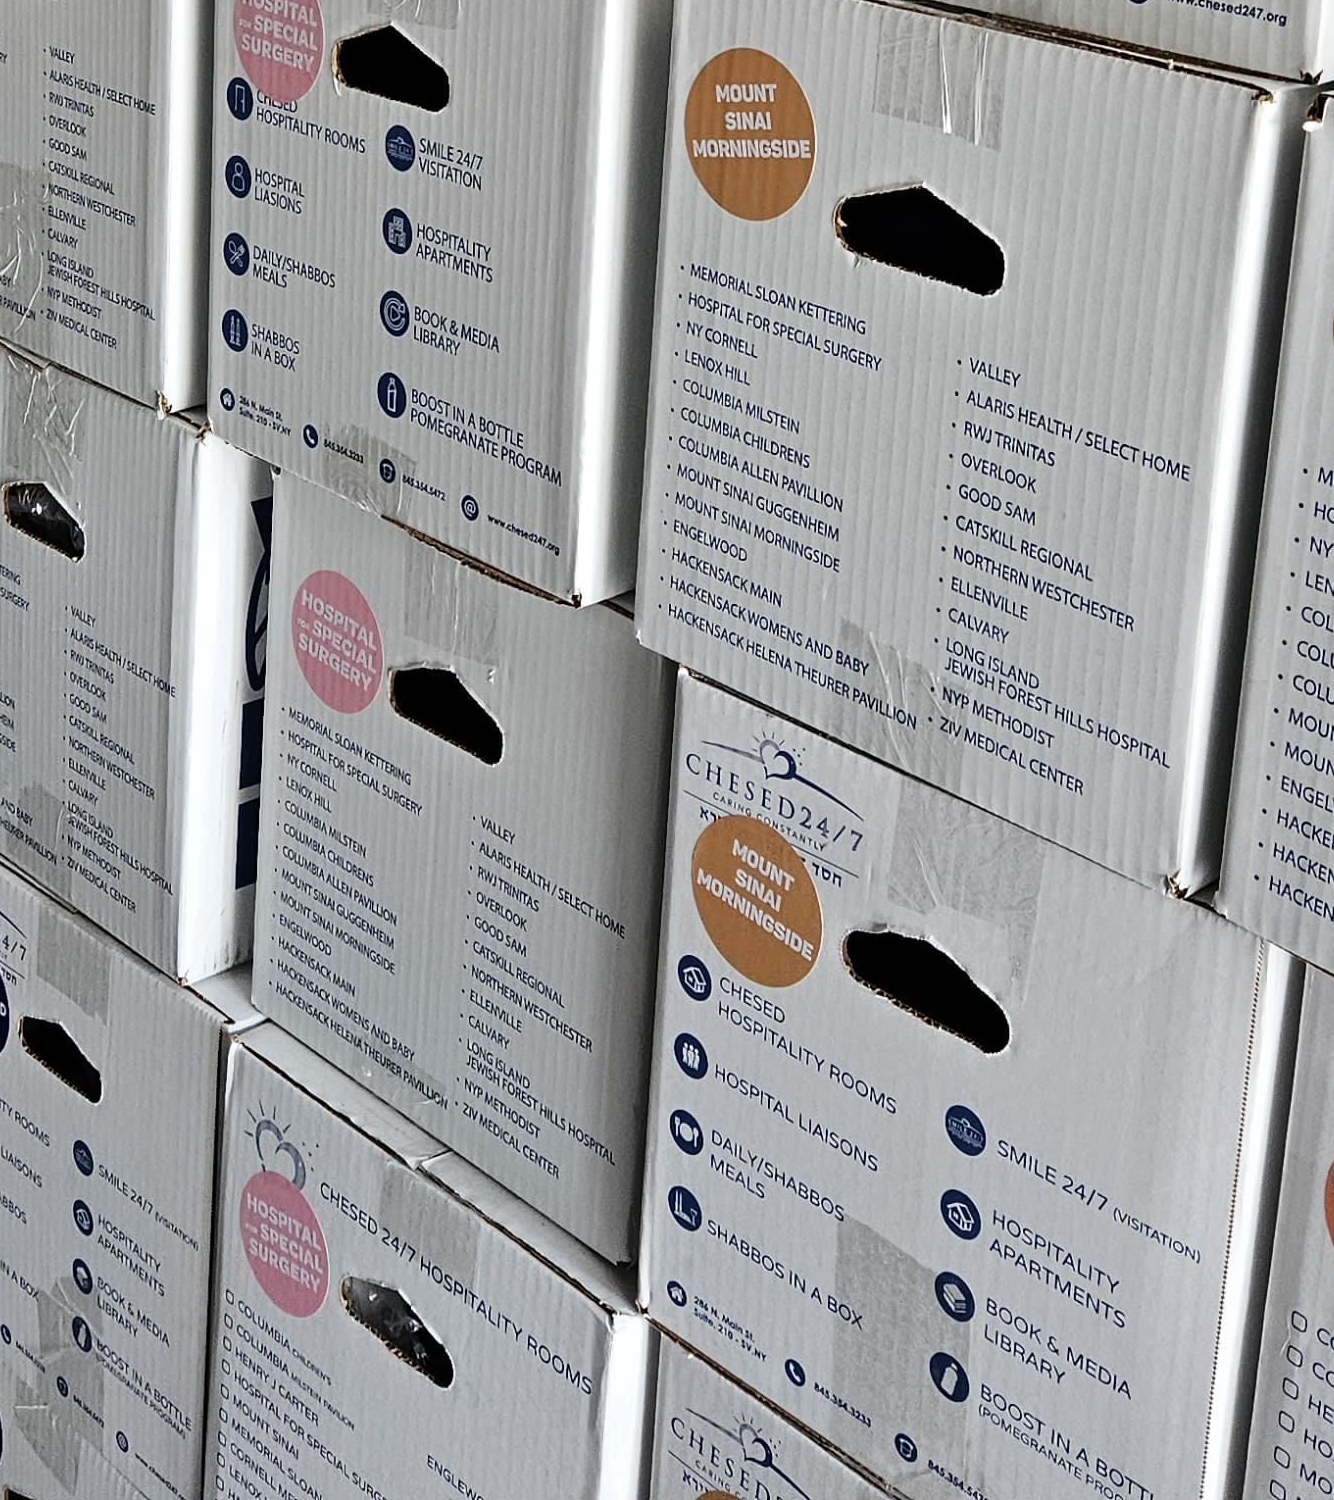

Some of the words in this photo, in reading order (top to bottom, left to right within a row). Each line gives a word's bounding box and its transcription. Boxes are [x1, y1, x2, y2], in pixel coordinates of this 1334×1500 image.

[242, 34, 314, 72] SURGERY
[254, 15, 317, 51] SPECIAL
[716, 84, 776, 102] MOUNT
[725, 112, 771, 130] SINAI
[693, 140, 815, 164] MORNINGSIDE
[254, 246, 335, 287] DAILY/SHABBOS
[956, 516, 1017, 551] CATSKILL
[1021, 540, 1092, 581] REGIONAL
[733, 840, 794, 889] MOUNT
[735, 869, 781, 911] SINAI
[697, 870, 817, 966] MORNINGSIDE
[715, 1067, 793, 1123] HOSPITAL
[799, 1114, 877, 1171] LIAISONS
[247, 1195, 321, 1250] HOSPITAL
[998, 1141, 1056, 1185] SMILE
[1062, 1176, 1107, 1210] 24/7
[1114, 1208, 1200, 1263] (VISITATION)
[250, 1238, 320, 1294] SURGERY
[261, 1225, 324, 1273] SPECIAL
